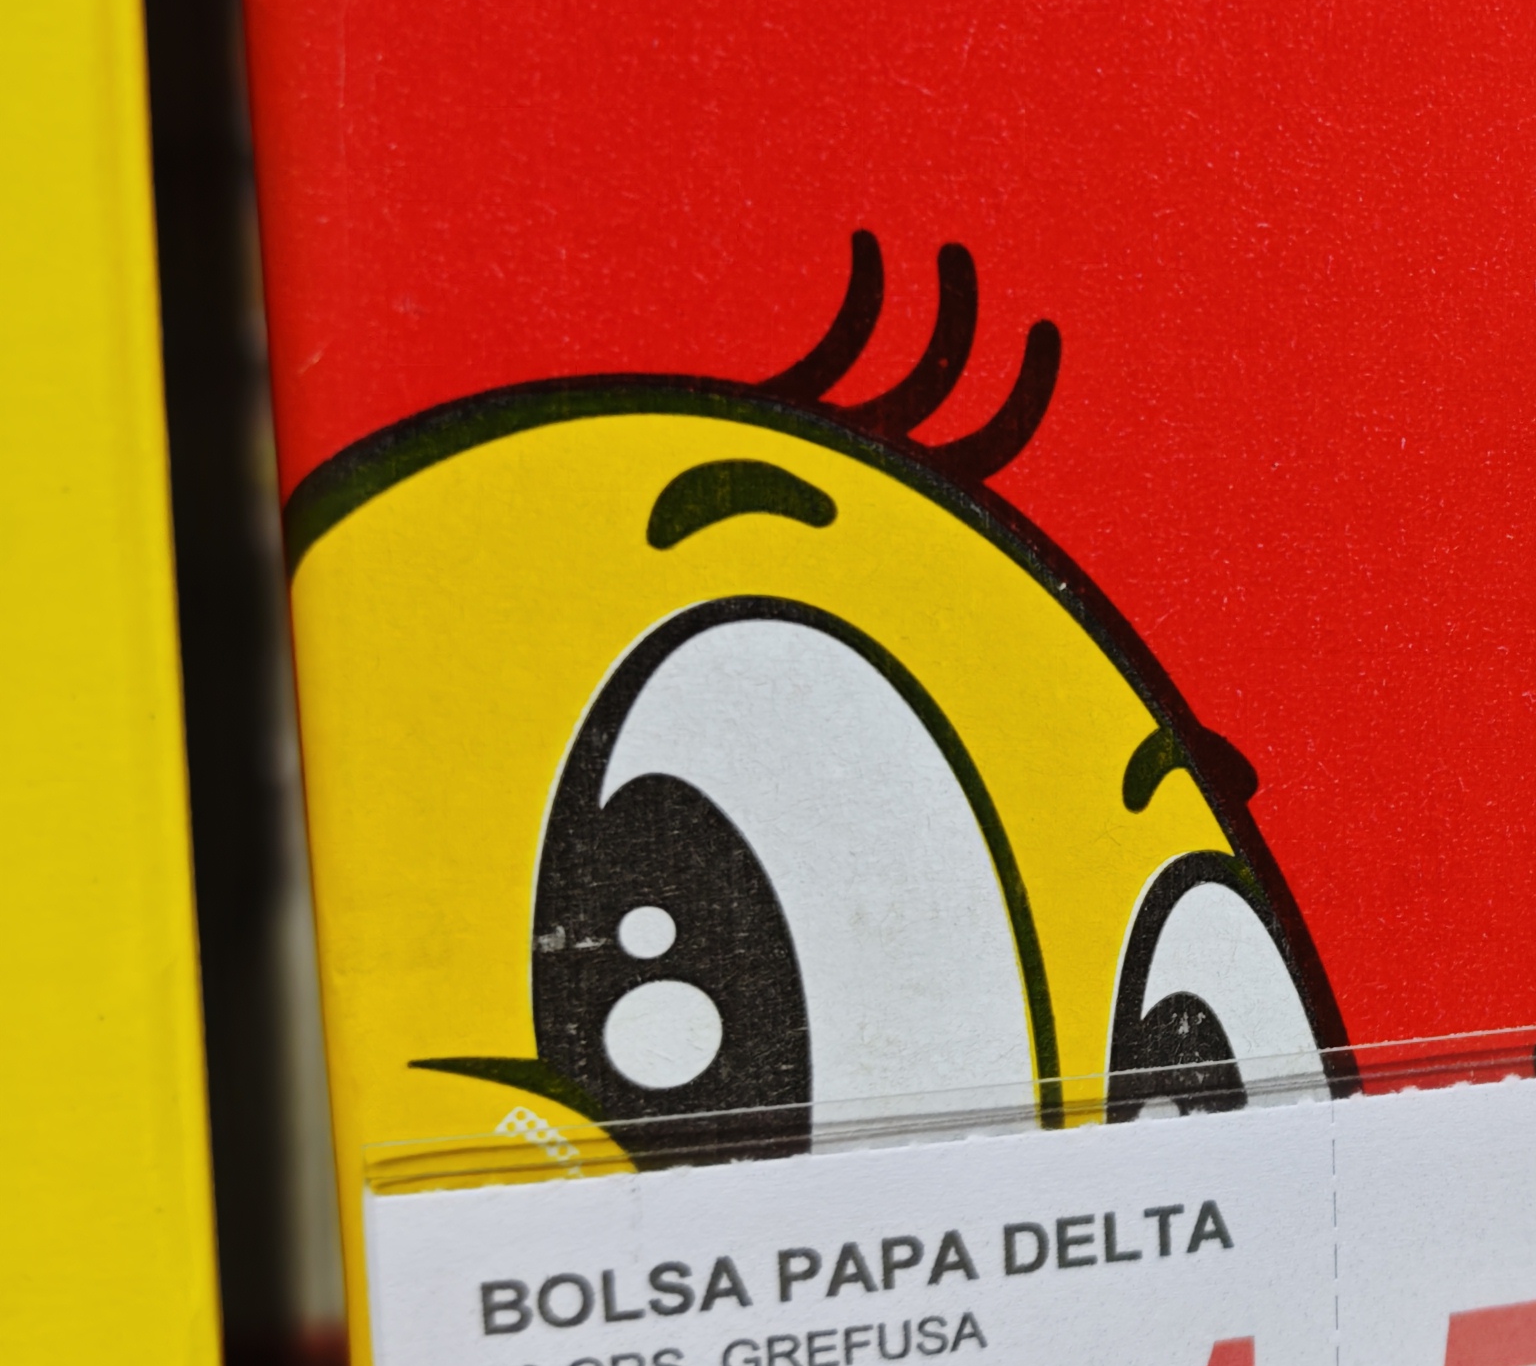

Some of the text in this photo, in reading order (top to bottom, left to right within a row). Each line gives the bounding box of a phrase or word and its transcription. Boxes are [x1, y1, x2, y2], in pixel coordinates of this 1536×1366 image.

[480, 1200, 1234, 1336] BOLSA PAPA DELTA
